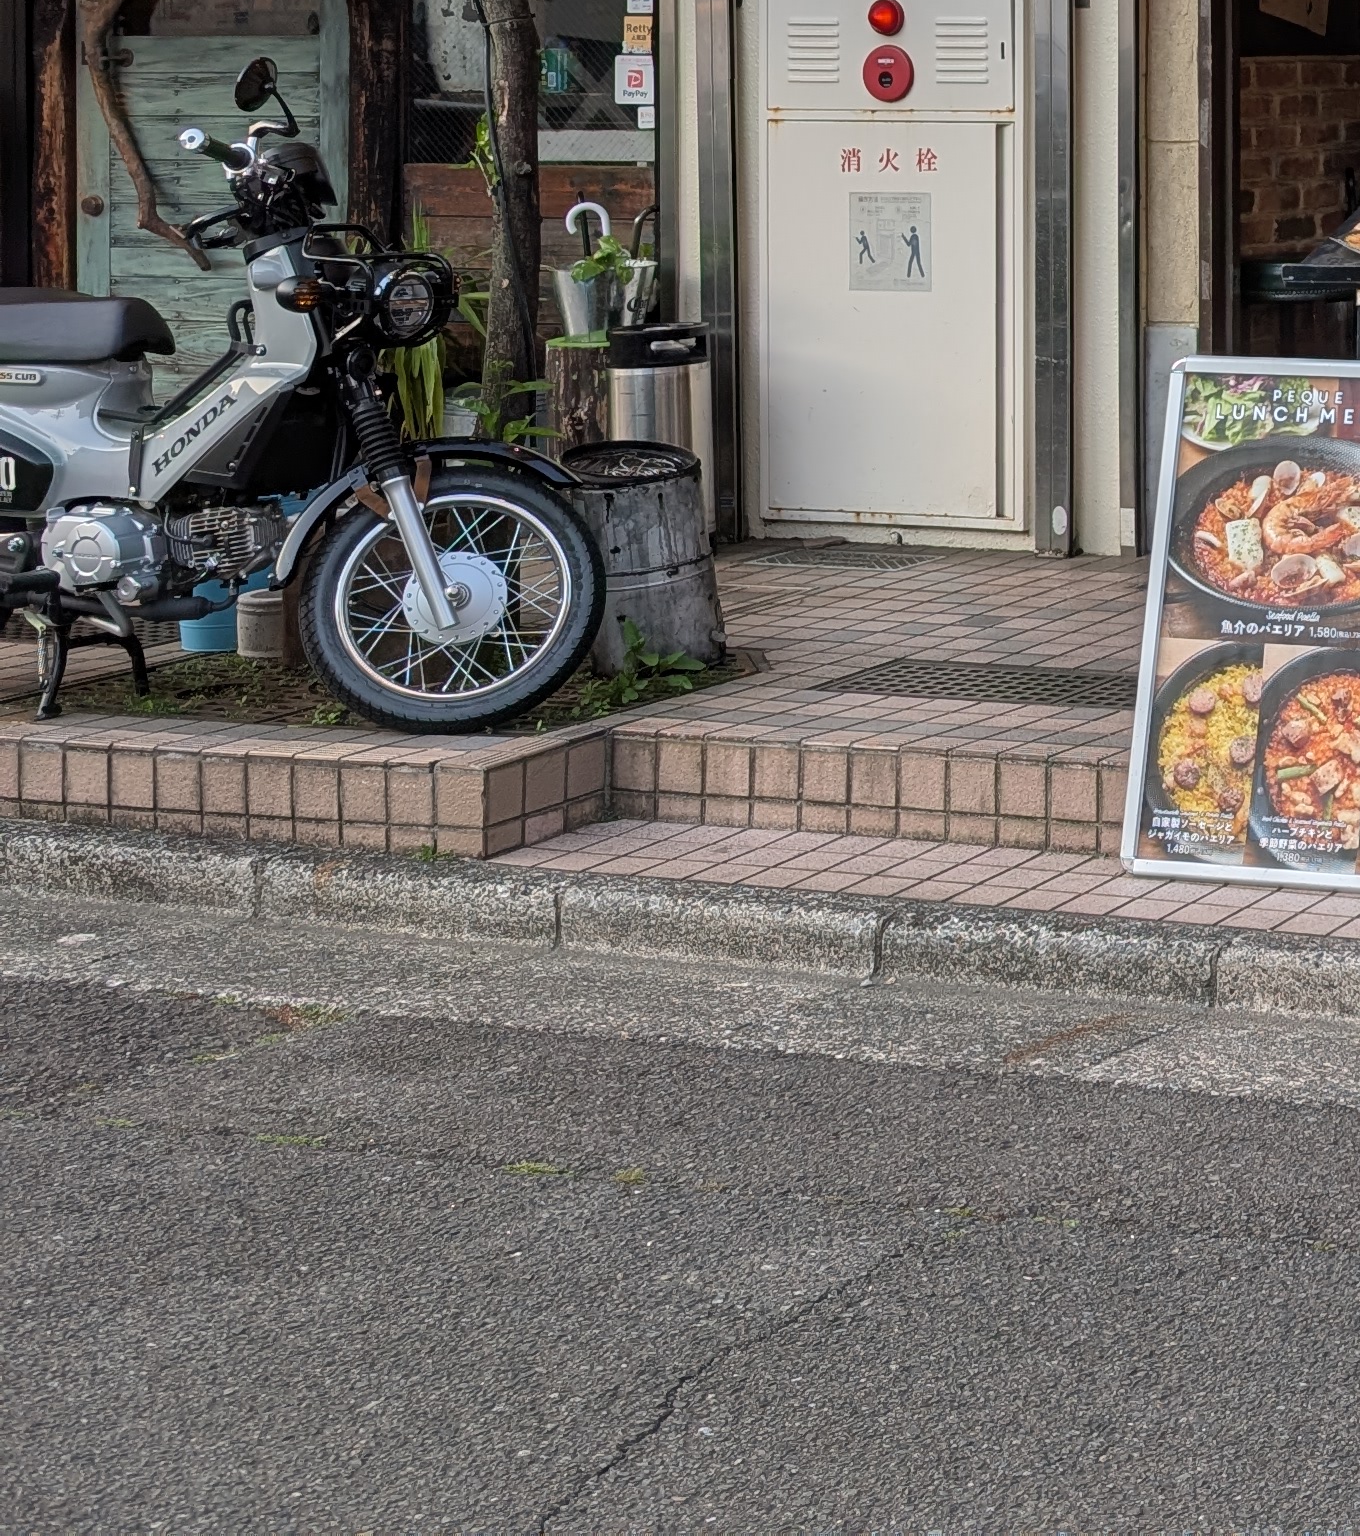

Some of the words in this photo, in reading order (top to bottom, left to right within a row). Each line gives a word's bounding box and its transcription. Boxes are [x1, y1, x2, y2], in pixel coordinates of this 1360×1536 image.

[626, 23, 652, 35] Retty
[623, 89, 648, 99] PayPay
[840, 147, 938, 173] 消火栓
[15, 372, 37, 381] CUB
[1273, 389, 1344, 406] PEQUE
[1215, 403, 1309, 423] LUNCH
[152, 394, 238, 477] HONDA
[1266, 610, 1297, 622] Seafood
[1296, 611, 1321, 622] Paella
[1220, 619, 1305, 637] 魚介のパエリア
[1309, 626, 1337, 639] 1,580
[1151, 817, 1234, 832] 自家製ソーセージと
[1147, 828, 1235, 845] ジャガイモのパエリア
[1271, 827, 1333, 839] ハーブチキンと
[1166, 843, 1190, 855] 1,480
[1258, 837, 1343, 853] 季節野菜のパエリア
[1276, 852, 1300, 862] 1,380
